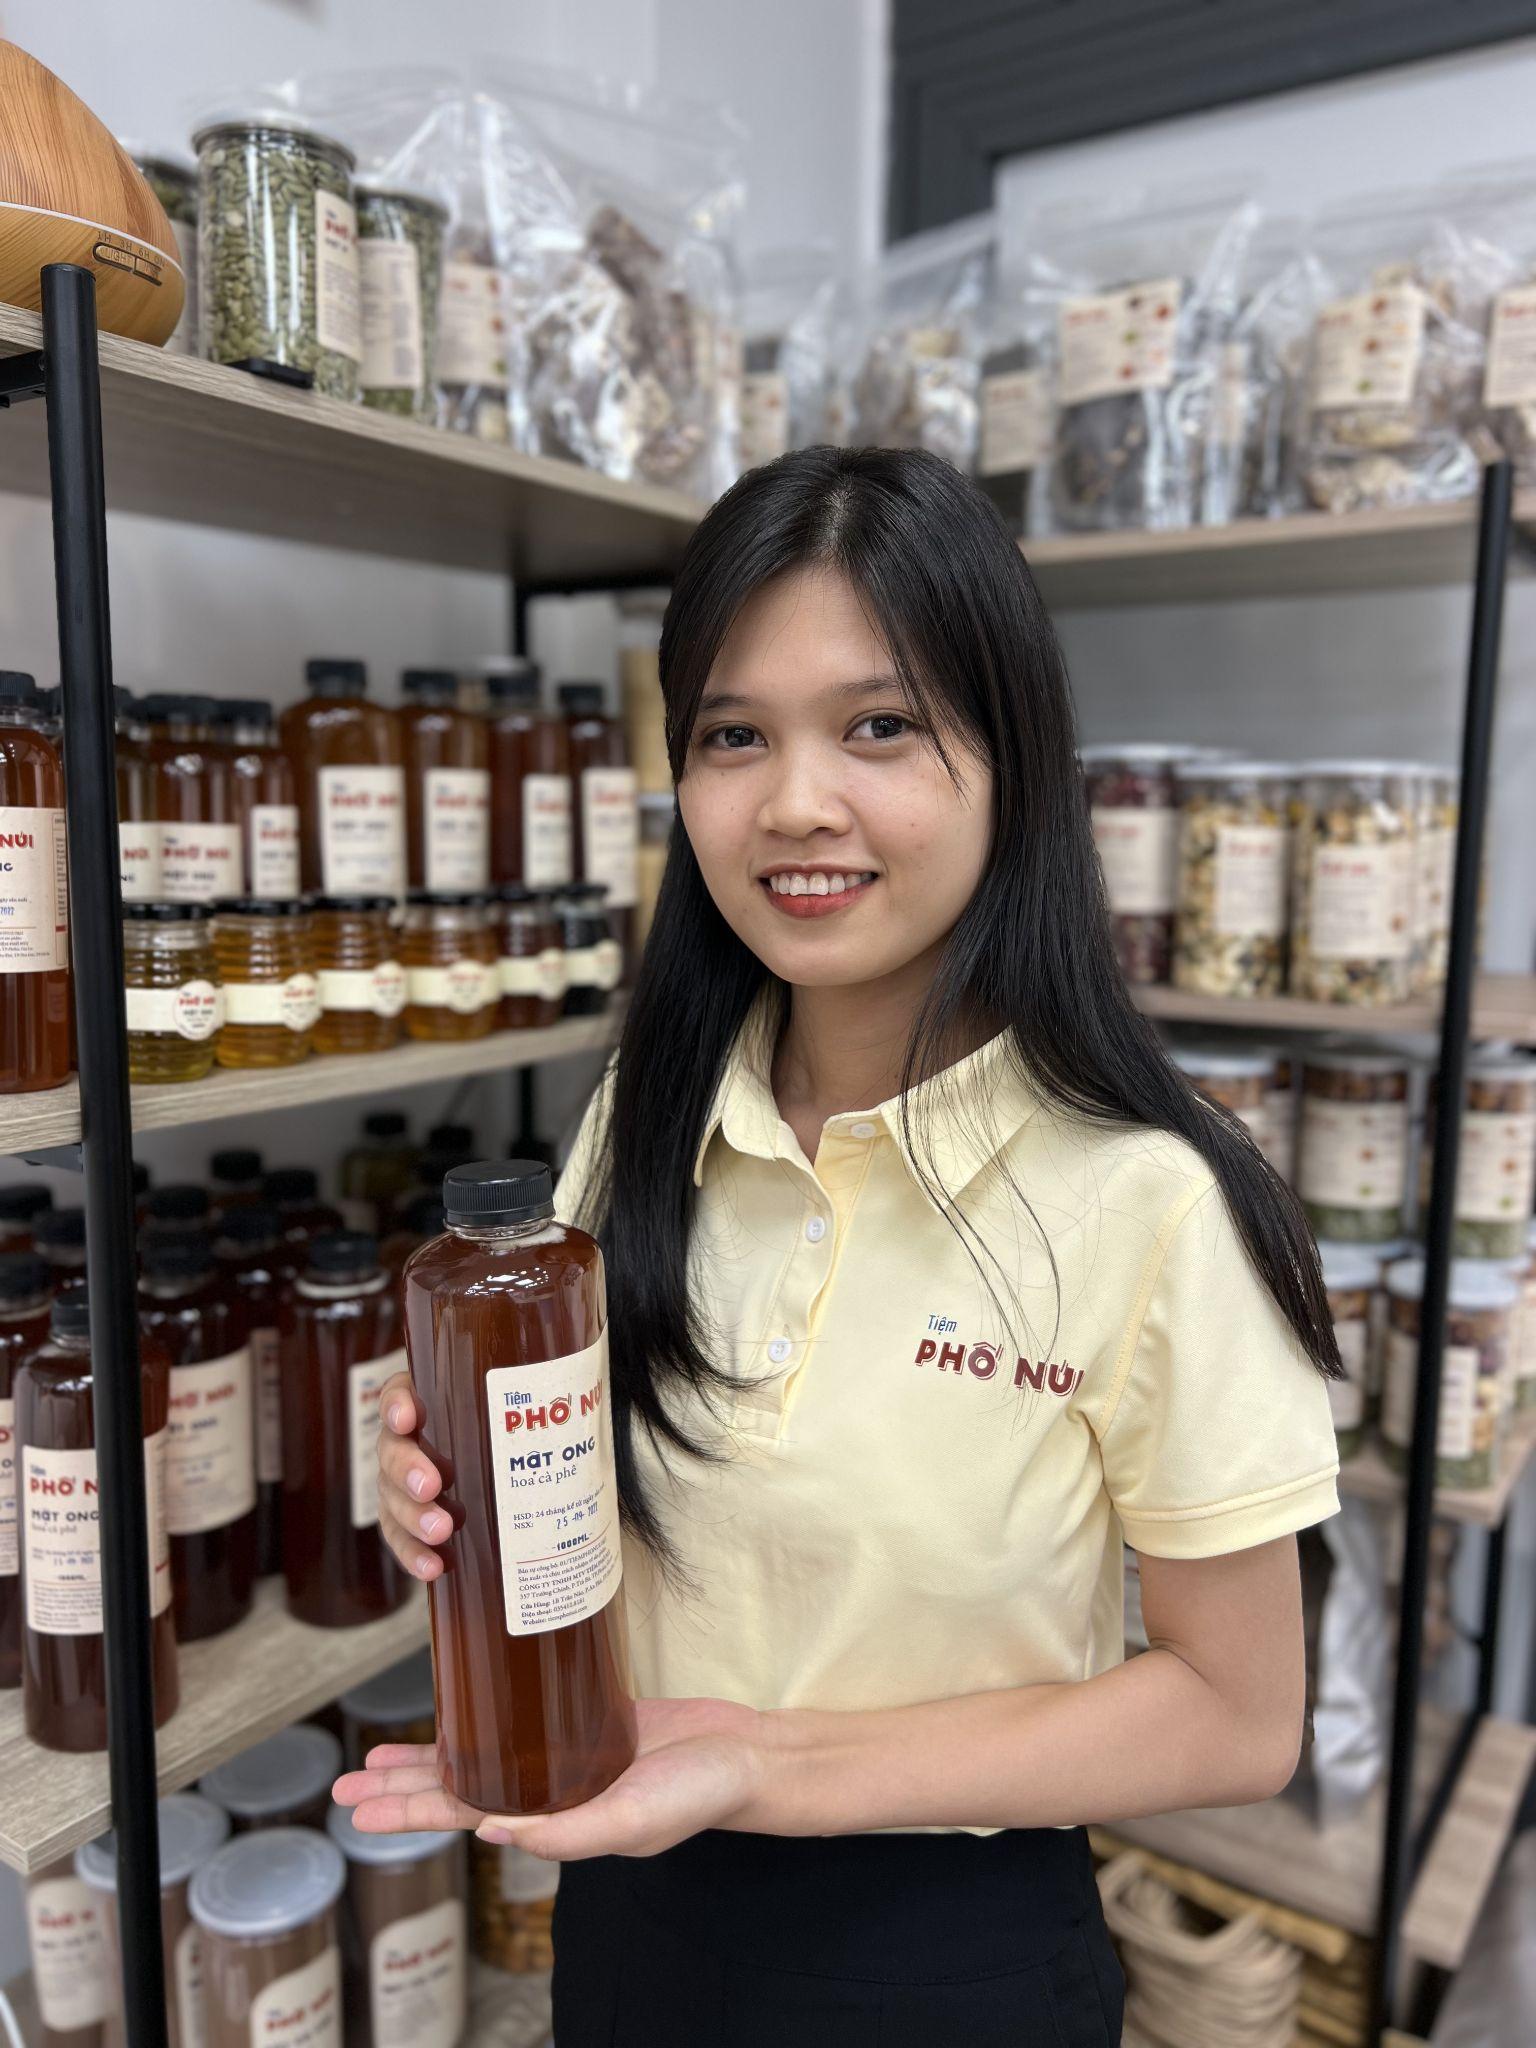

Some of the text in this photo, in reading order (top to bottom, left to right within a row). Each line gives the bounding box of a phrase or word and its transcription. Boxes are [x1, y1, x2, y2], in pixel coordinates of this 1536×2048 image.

[928, 1315, 957, 1335] Tiệm
[915, 1338, 1004, 1380] PHỐ
[504, 1392, 531, 1410] Tiệm
[505, 1392, 572, 1433] PHỐ
[510, 1436, 596, 1475] MẬT ONG
[511, 1464, 577, 1488] hoa cà phê
[513, 1513, 533, 1521] HSD:
[514, 1521, 533, 1529] NSX:
